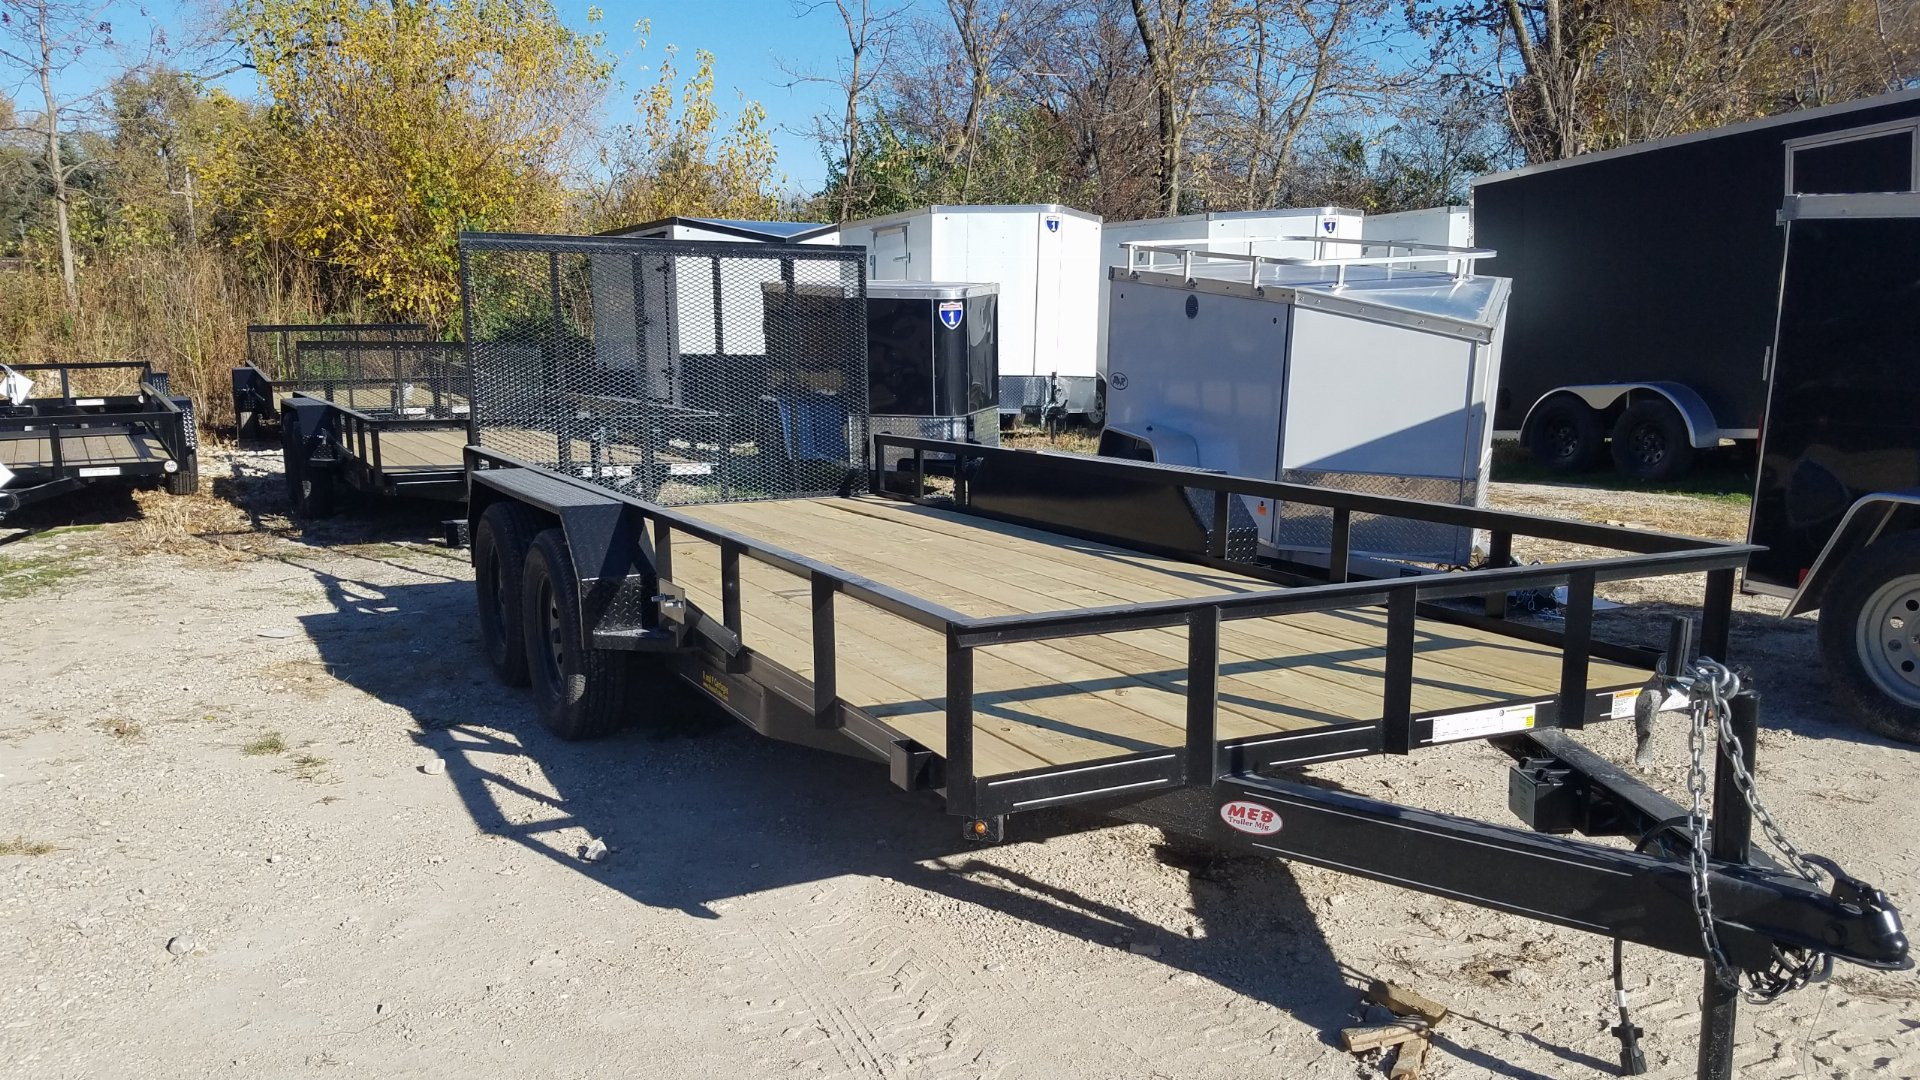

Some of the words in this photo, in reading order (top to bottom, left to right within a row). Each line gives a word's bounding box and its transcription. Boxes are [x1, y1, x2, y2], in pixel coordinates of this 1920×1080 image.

[949, 311, 956, 325] 1
[1228, 815, 1253, 827] Trailer
[1254, 821, 1271, 831] Mfg.
